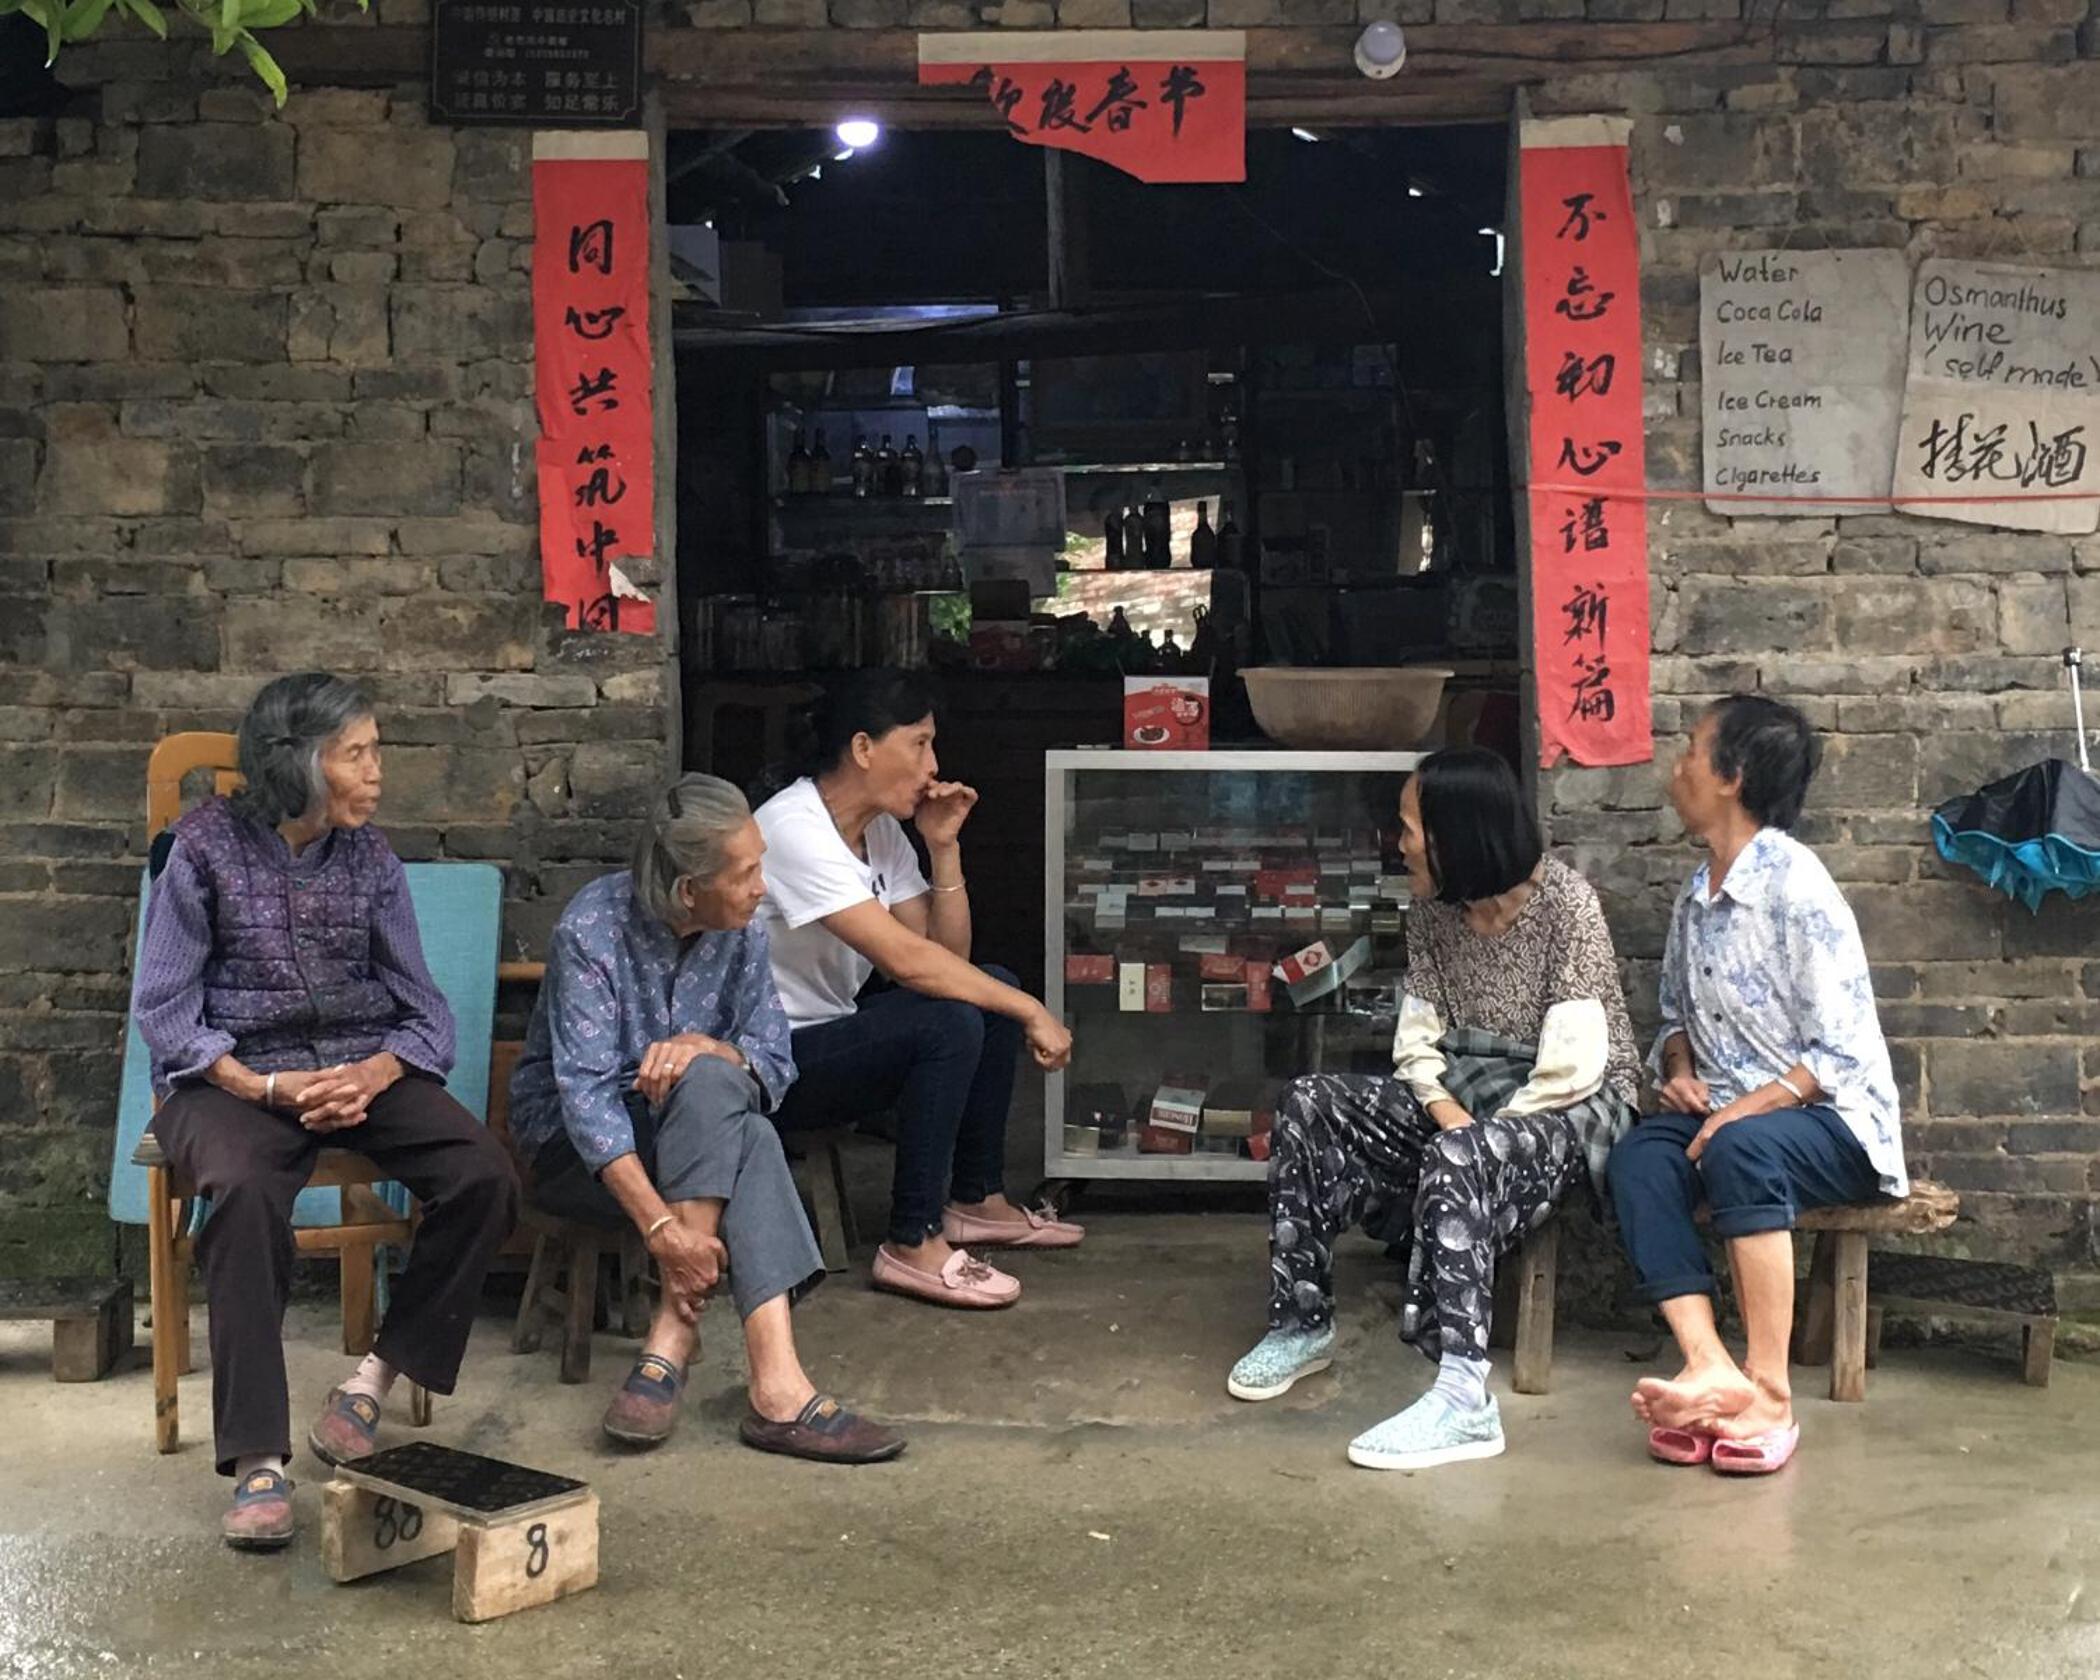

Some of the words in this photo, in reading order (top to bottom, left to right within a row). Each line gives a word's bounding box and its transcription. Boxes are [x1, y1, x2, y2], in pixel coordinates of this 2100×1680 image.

[1719, 257, 1799, 283] Water
[1924, 276, 2067, 319] Osmanthus
[1716, 300, 1771, 324] Coca
[1777, 299, 1823, 321] Cola
[1924, 311, 2012, 344] Wine
[1717, 340, 1745, 365] Ice
[1751, 343, 1793, 364] Tea
[1717, 391, 1749, 411] Ice
[1755, 390, 1822, 409] Cream
[1716, 427, 1787, 448] Snacks
[1554, 193, 1622, 722] 不忘初心谱新篇
[526, 1523, 549, 1578] 8
